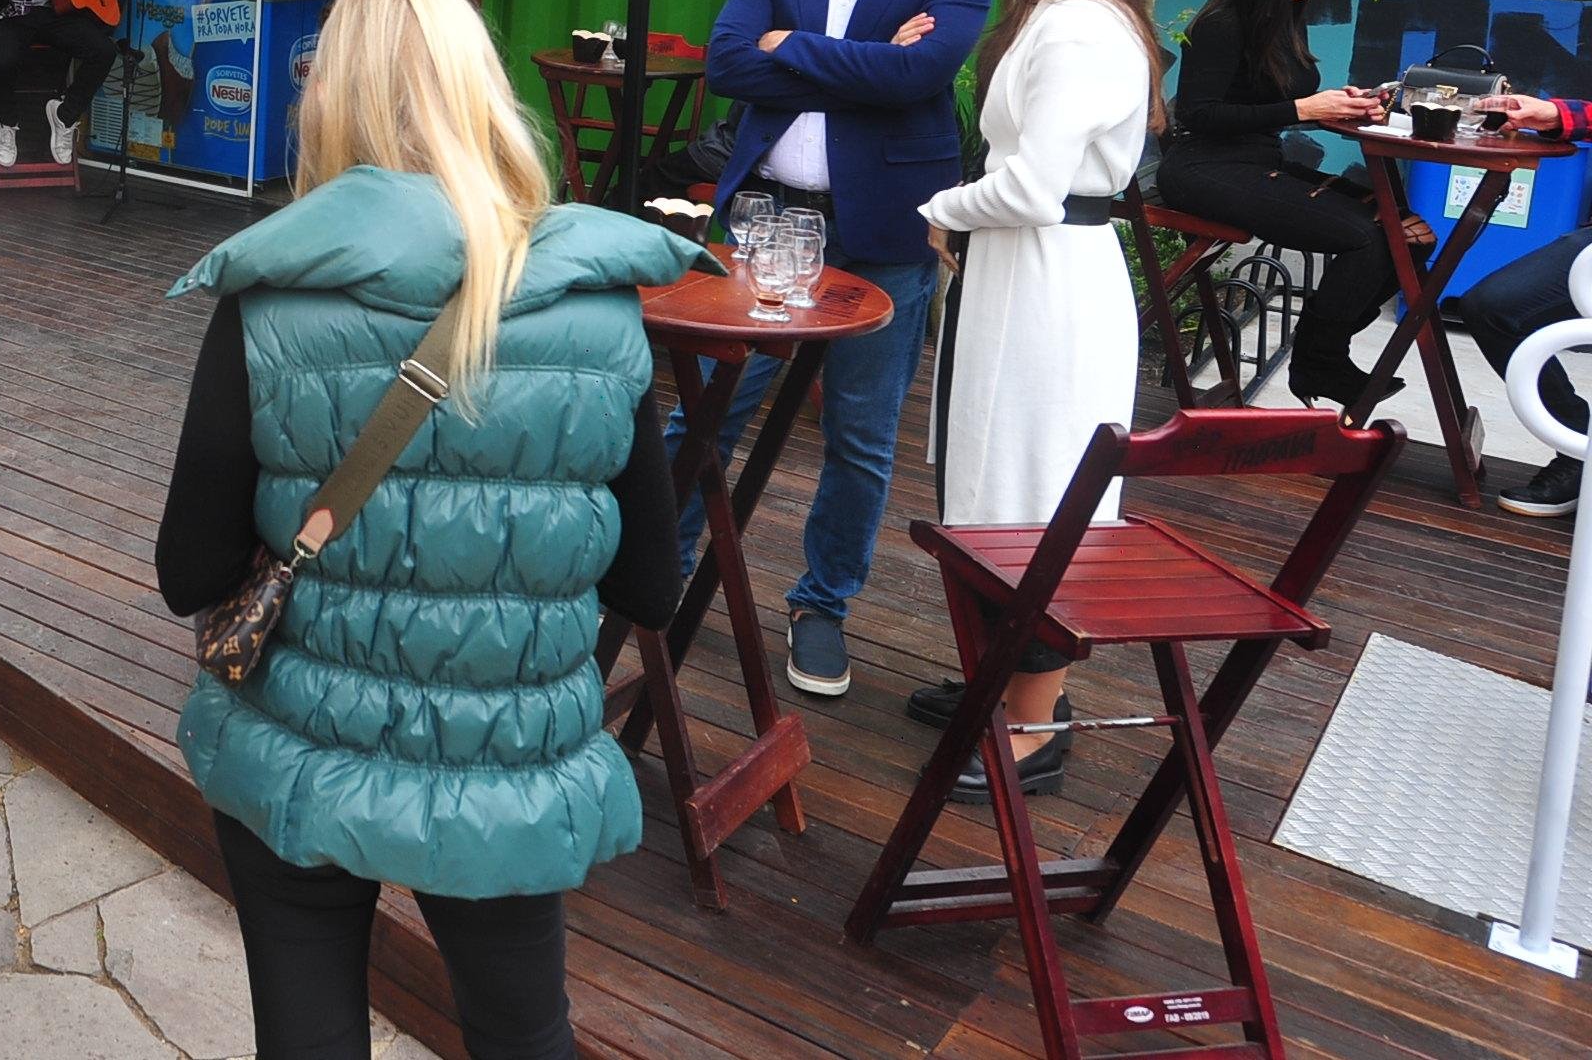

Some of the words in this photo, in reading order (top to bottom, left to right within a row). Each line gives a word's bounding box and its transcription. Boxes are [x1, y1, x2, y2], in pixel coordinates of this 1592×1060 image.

[196, 4, 250, 24] #SORVETE
[214, 23, 233, 36] TODA
[234, 20, 256, 34] HORA
[215, 68, 249, 80] SORVETES
